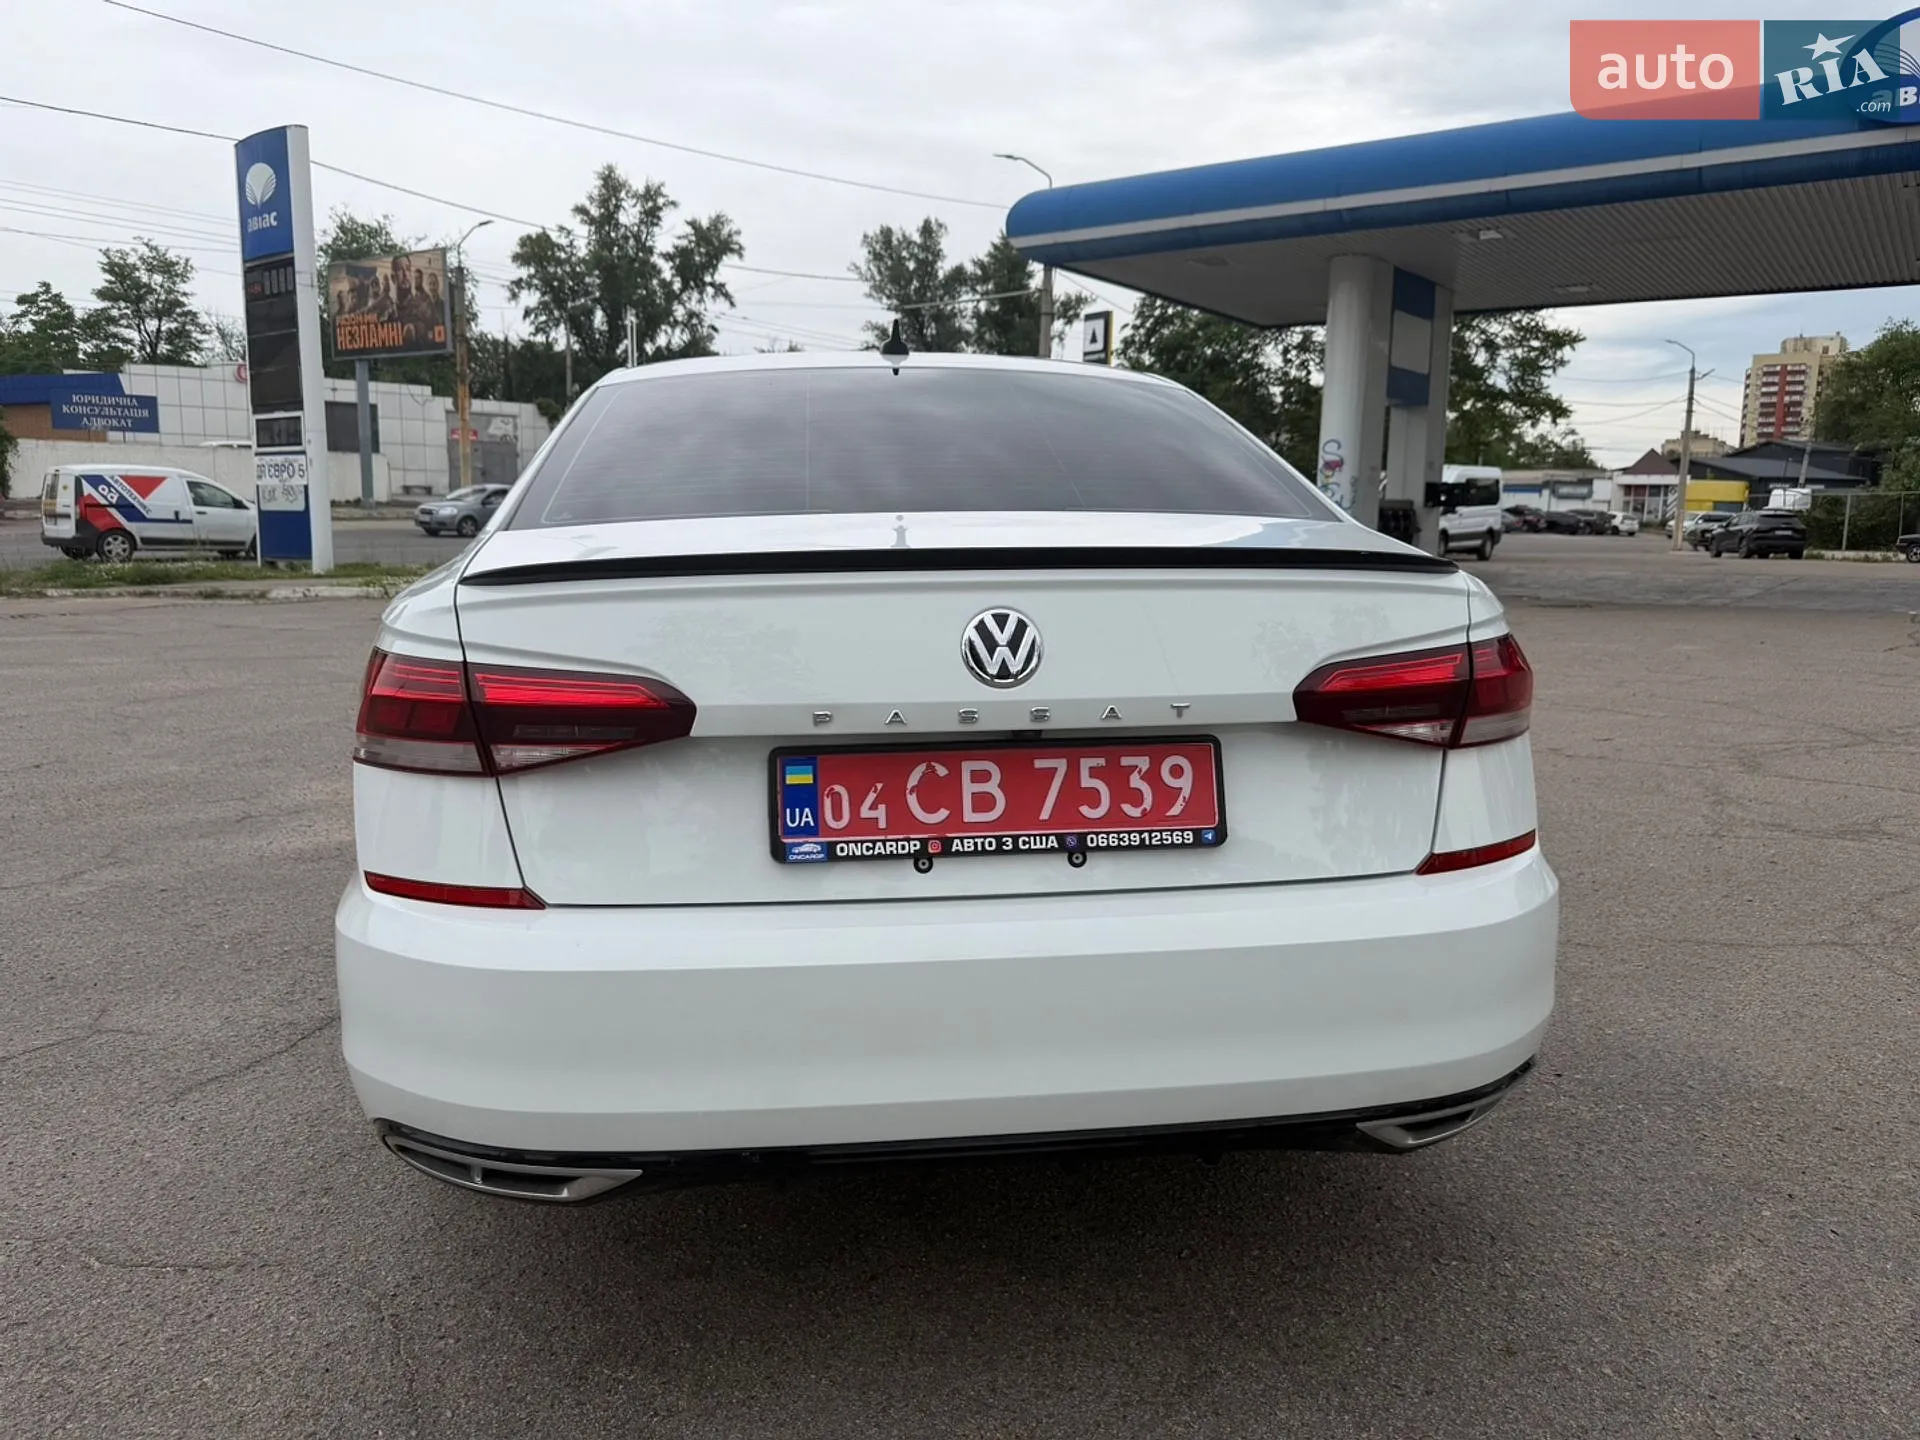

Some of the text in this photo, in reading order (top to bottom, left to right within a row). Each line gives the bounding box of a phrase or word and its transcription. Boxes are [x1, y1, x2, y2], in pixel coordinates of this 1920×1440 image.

[336, 321, 403, 350] НЕЗЛАМНІ
[71, 394, 138, 406] ЮРИДИЧНА
[62, 404, 150, 418] КОНСУЛЬТАЦІЯ
[81, 417, 133, 428] АДВОКАТ
[298, 463, 305, 479] 5
[812, 702, 1191, 727] PASSAT
[823, 782, 888, 830] 04
[1033, 754, 1194, 821] 7539
[785, 807, 815, 828] UA
[951, 837, 996, 853] АВТО
[1018, 835, 1059, 850] США
[1086, 830, 1194, 848] 0663912569
[836, 840, 921, 857] ONCARDP
